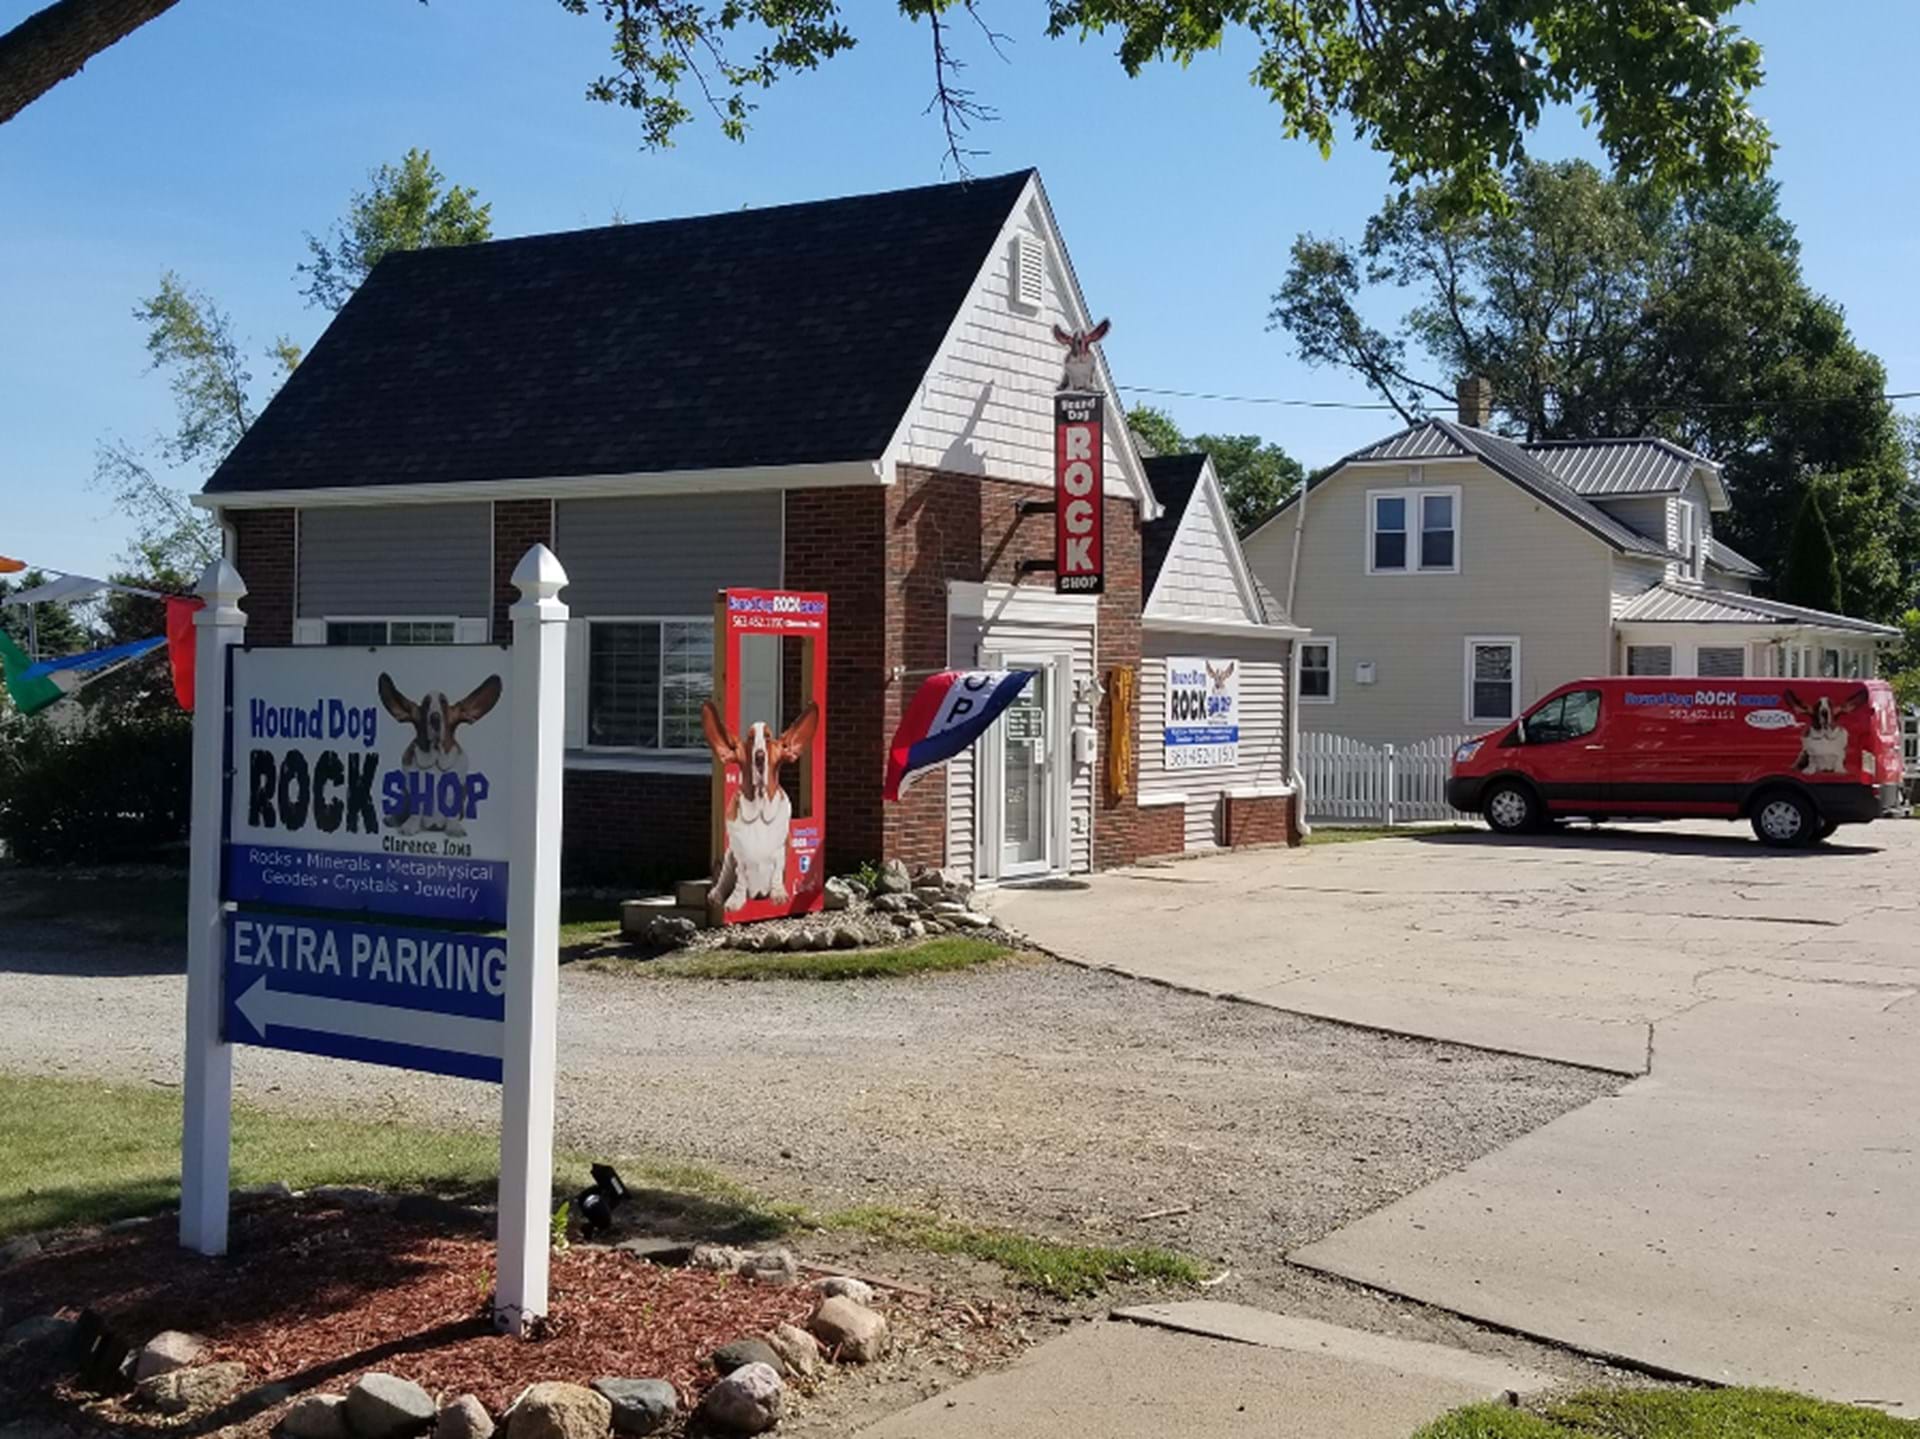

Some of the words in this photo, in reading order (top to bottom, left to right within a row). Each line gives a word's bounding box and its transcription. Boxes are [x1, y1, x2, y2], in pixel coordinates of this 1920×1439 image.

[1064, 426, 1094, 572] ROCK
[1061, 577, 1098, 589] SHOP
[1171, 690, 1207, 720] ROCK
[1695, 691, 1737, 705] ROCK
[250, 698, 323, 740] Hound
[328, 699, 377, 747] Dog
[248, 749, 379, 834] ROCK
[382, 769, 489, 820] SHOP
[249, 848, 292, 867] Rocks
[306, 853, 371, 871] Minerals
[387, 859, 493, 882] Metaphysical
[443, 839, 472, 857] Iowa
[262, 869, 317, 887] Geodes
[333, 874, 399, 893] Crystals
[414, 881, 479, 903] Jewelry
[234, 921, 341, 976] EXTRA
[351, 933, 507, 996] PARKING
